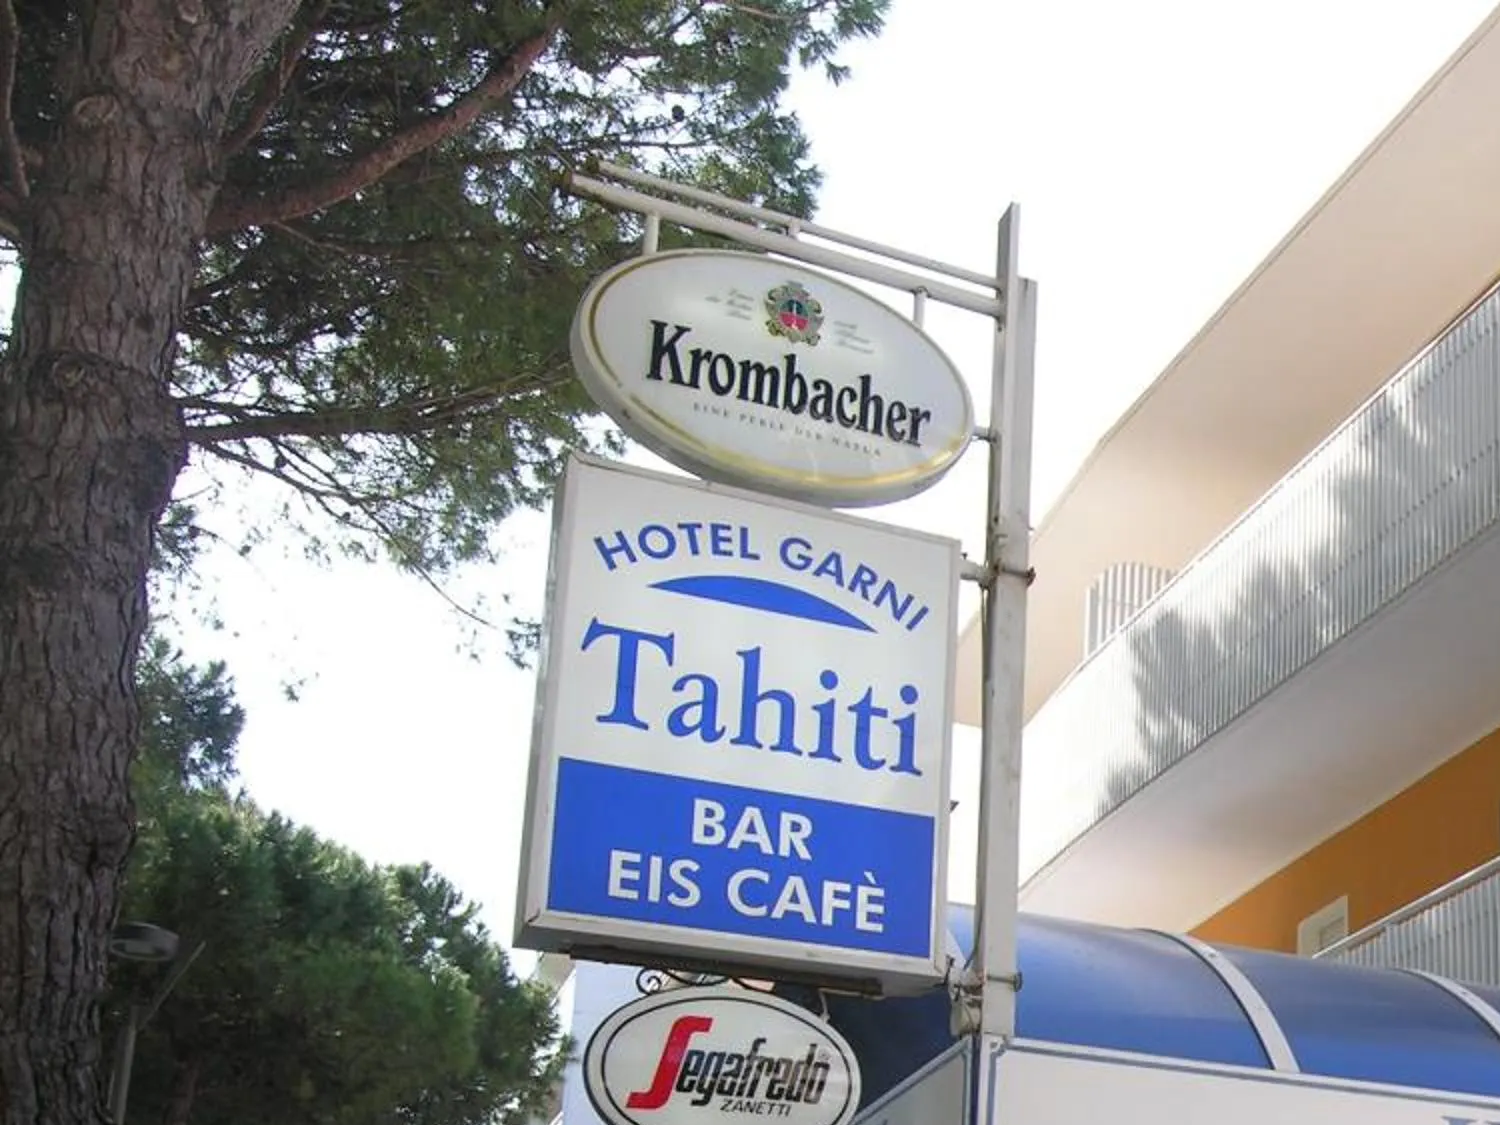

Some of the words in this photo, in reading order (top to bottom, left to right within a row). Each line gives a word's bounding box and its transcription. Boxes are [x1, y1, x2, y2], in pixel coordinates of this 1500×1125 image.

[646, 319, 931, 448] Krombacher
[594, 523, 760, 571] HOTEL
[778, 537, 928, 633] GARNI
[581, 616, 922, 777] Tahiti
[692, 797, 812, 860] BAR
[608, 850, 701, 908] EIS
[726, 870, 885, 933] CAFÈ
[625, 1015, 831, 1110] Segafredo
[719, 1099, 792, 1117] ZANETTI
